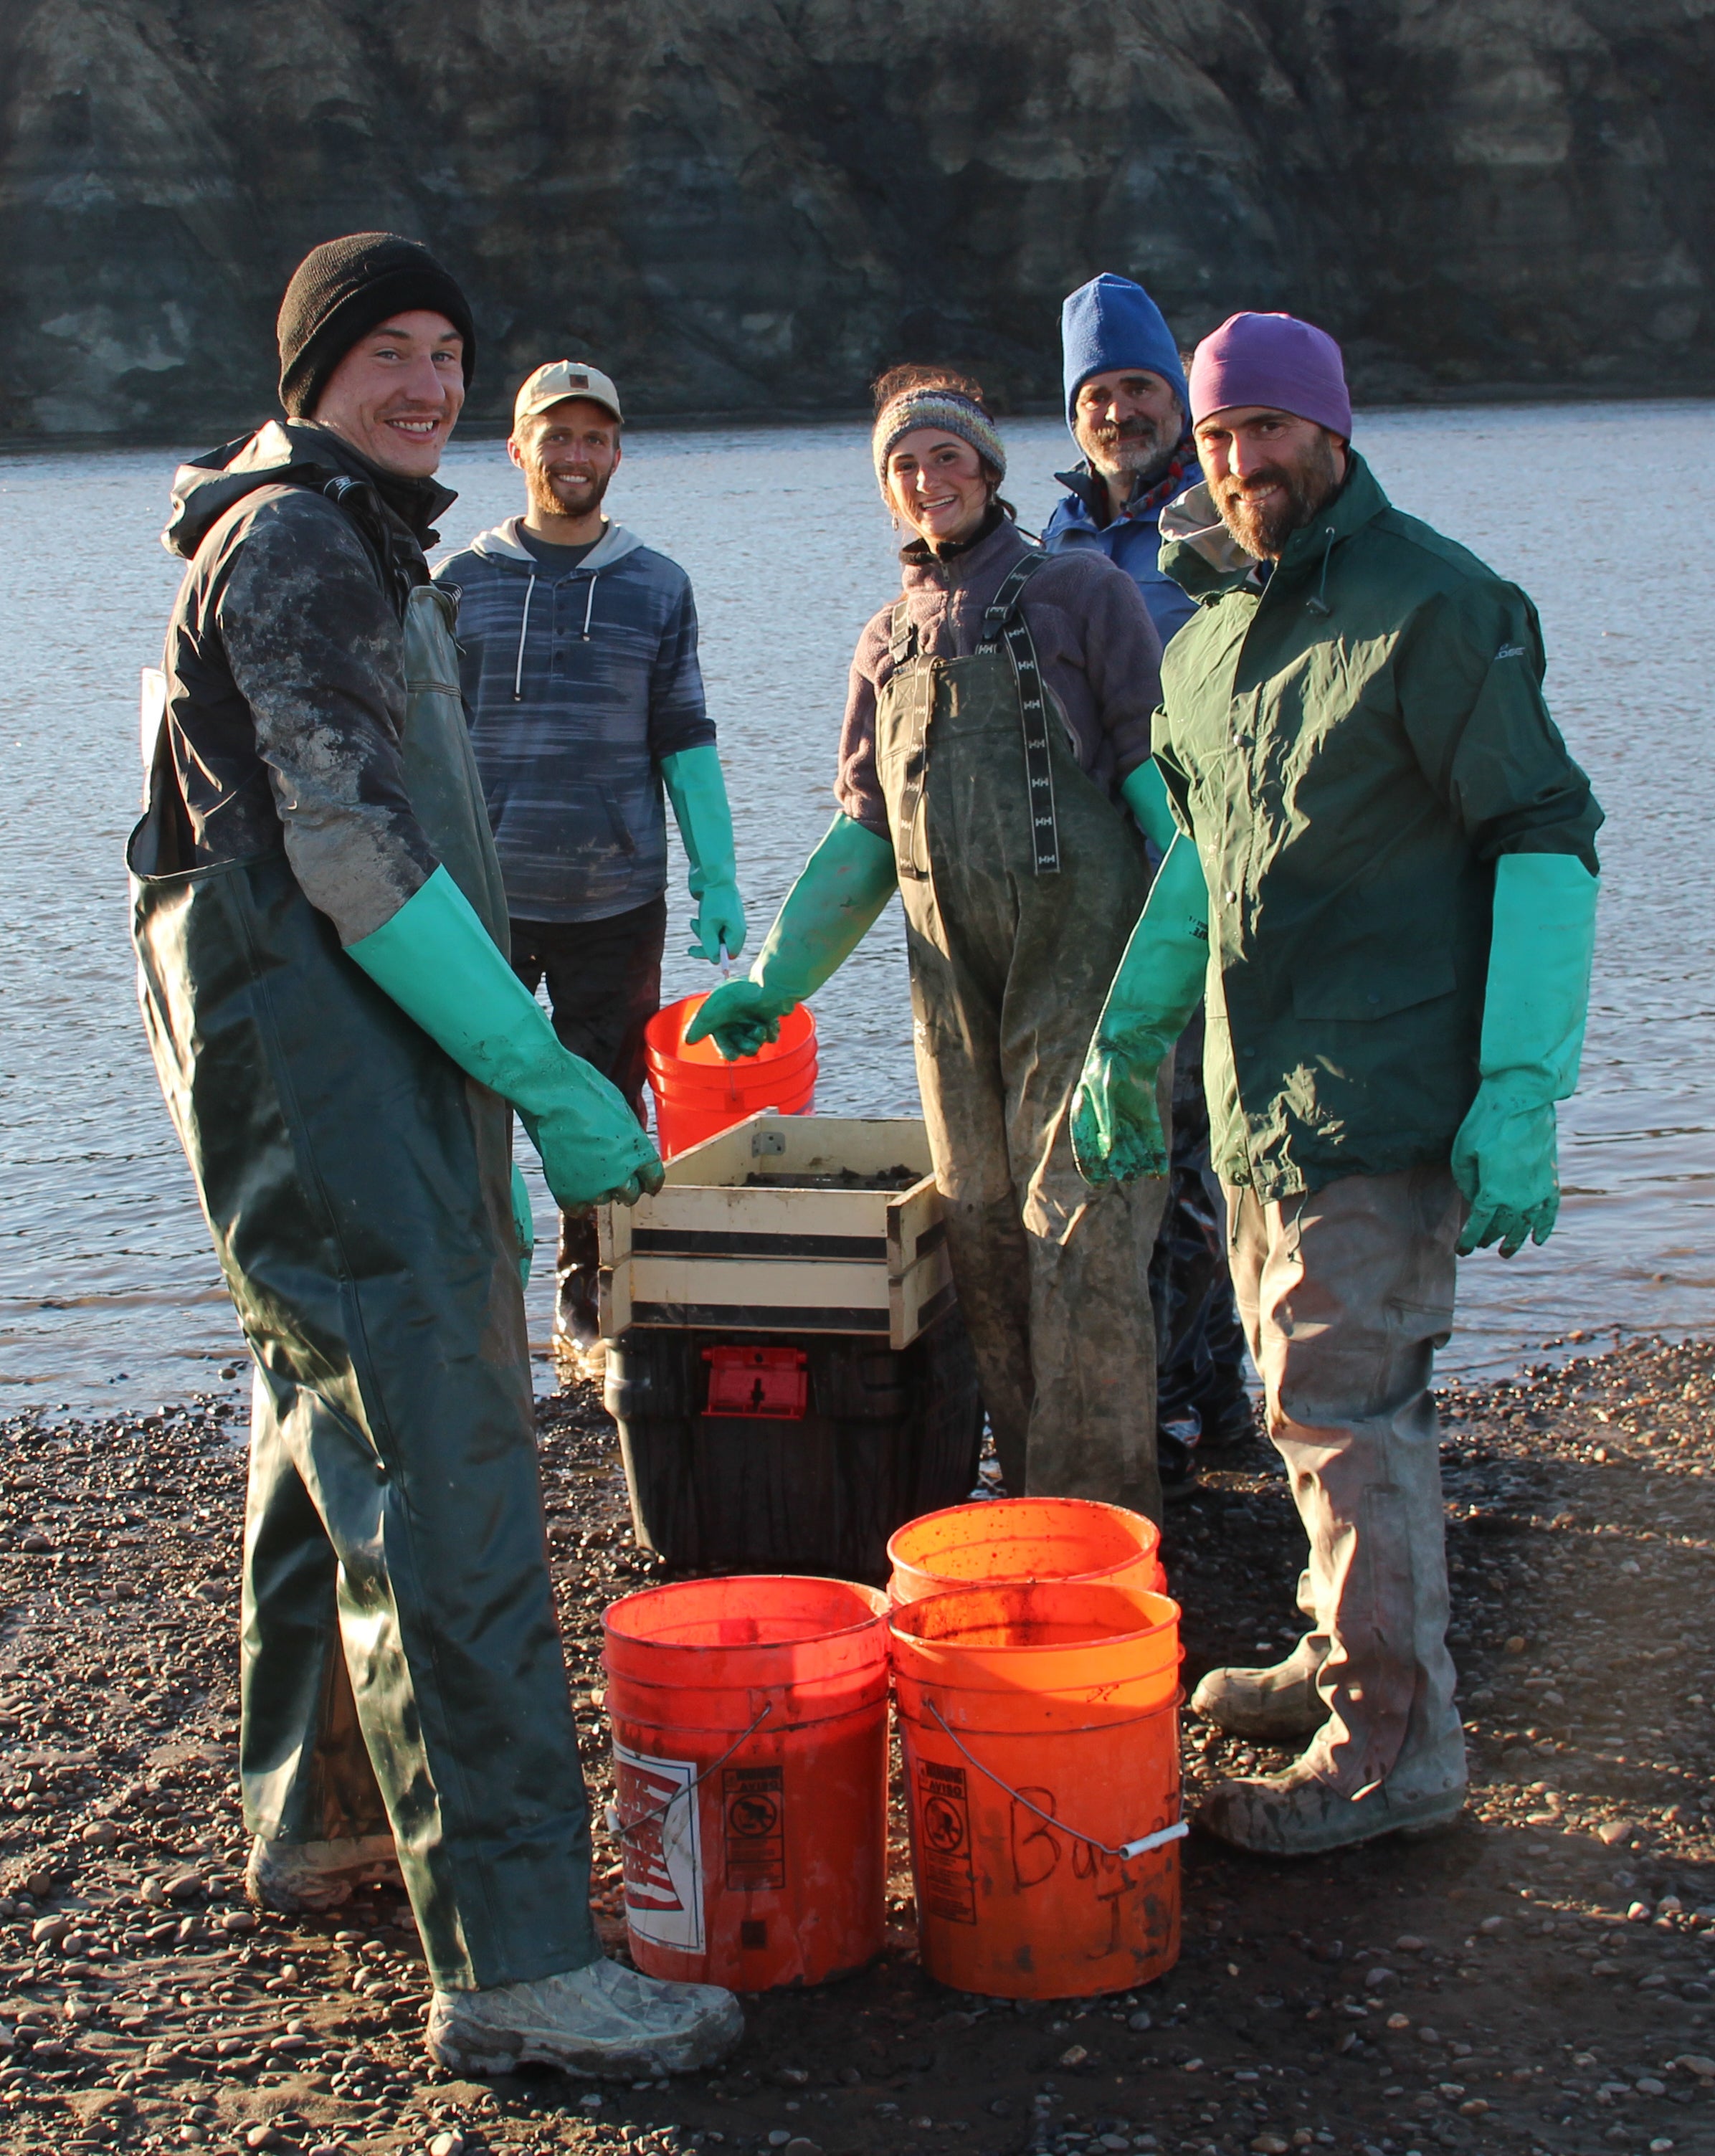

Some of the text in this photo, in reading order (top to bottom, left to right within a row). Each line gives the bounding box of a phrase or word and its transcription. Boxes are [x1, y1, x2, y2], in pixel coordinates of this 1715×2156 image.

[1018, 660, 1035, 671] HH
[1023, 699, 1040, 710] HH
[1028, 739, 1045, 749] HH
[1032, 778, 1049, 788] HH
[1035, 817, 1052, 827] HH
[1038, 855, 1055, 865] HH
[930, 1780, 961, 1798] AVISO
[1009, 1758, 1177, 1893] Bucet
